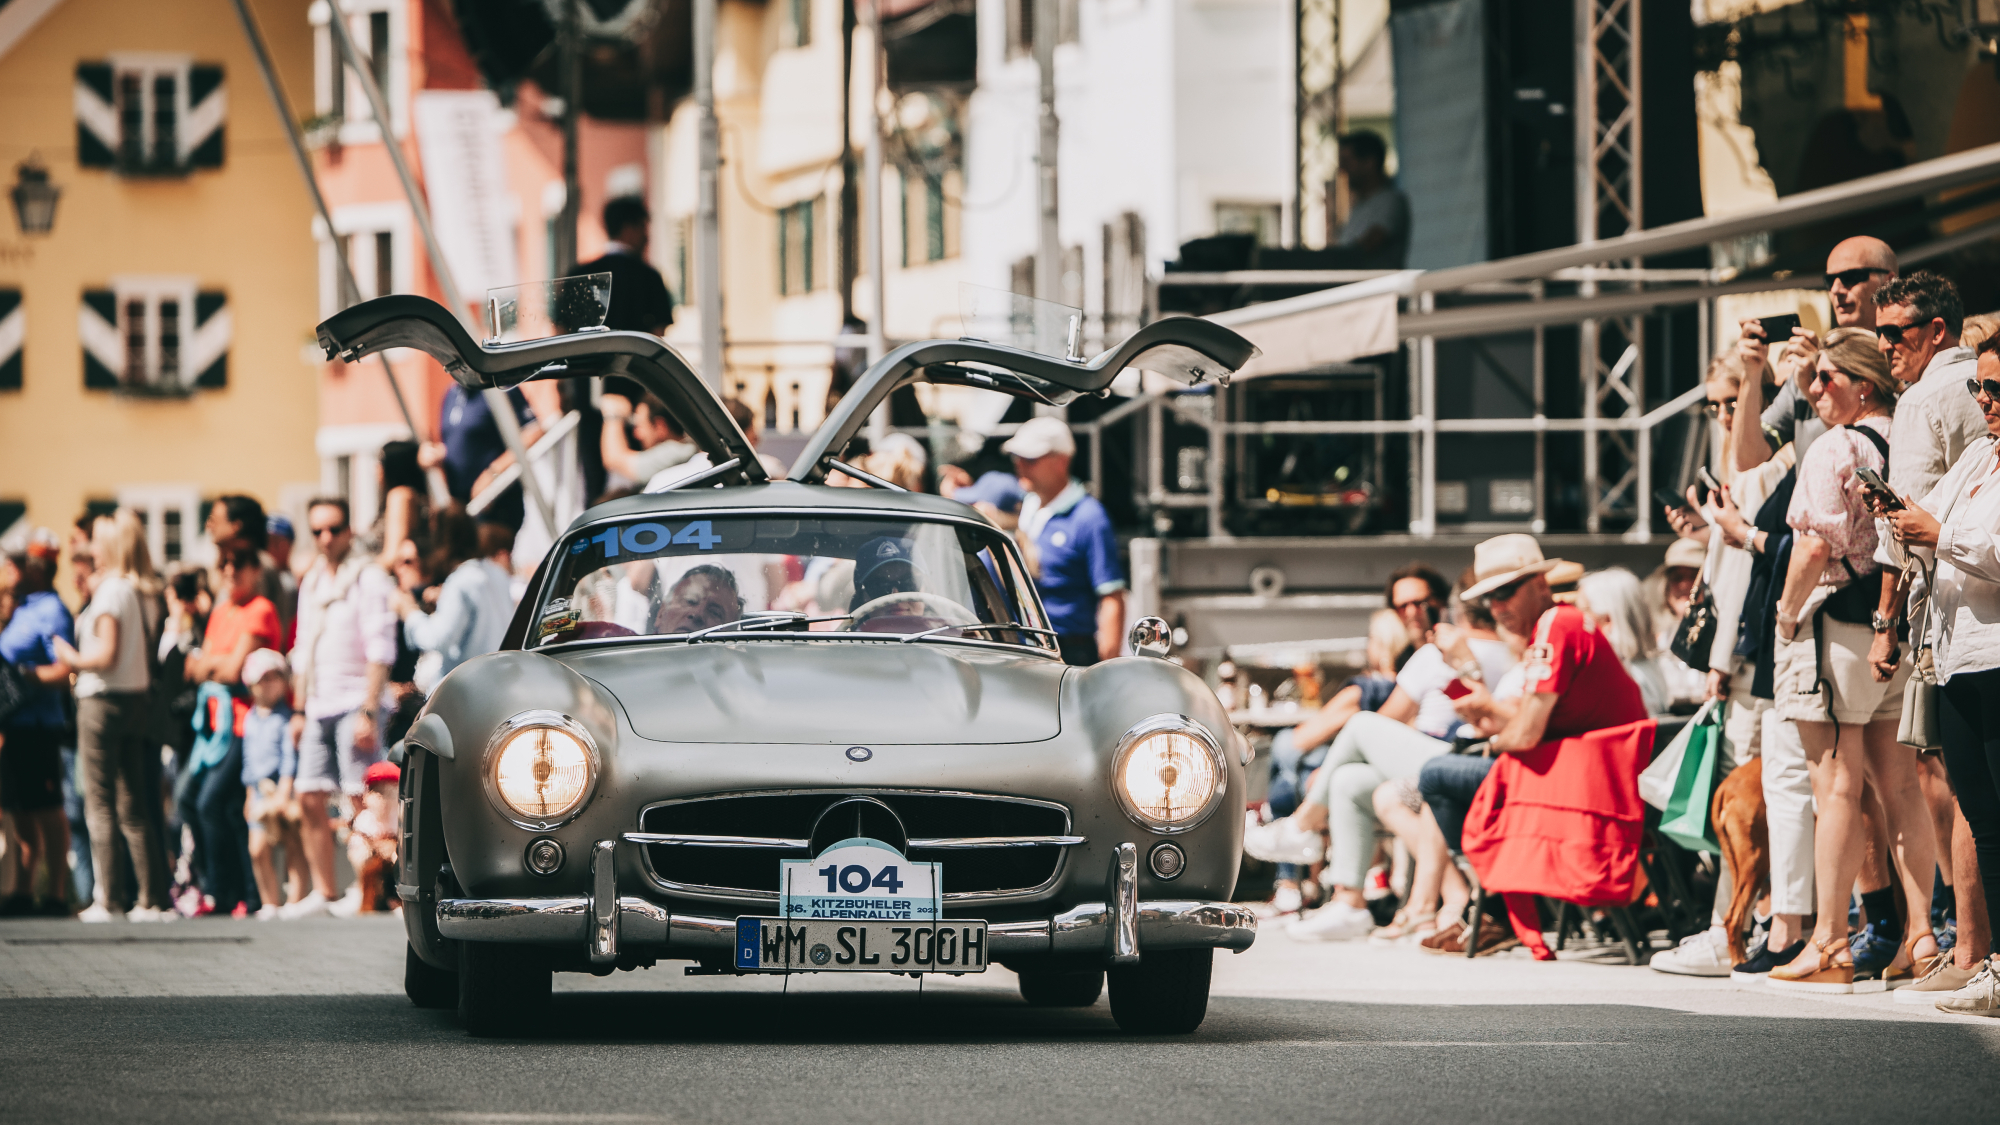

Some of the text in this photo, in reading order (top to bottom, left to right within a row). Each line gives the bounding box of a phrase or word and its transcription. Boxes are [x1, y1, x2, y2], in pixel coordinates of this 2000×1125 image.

[591, 520, 722, 558] 104
[818, 864, 904, 894] 104
[785, 904, 807, 913] 36.
[811, 898, 912, 910] KITZBÜHELER
[811, 909, 912, 919] ALPENRALLYE
[761, 925, 984, 966] WM SL 300H
[744, 948, 753, 959] D
